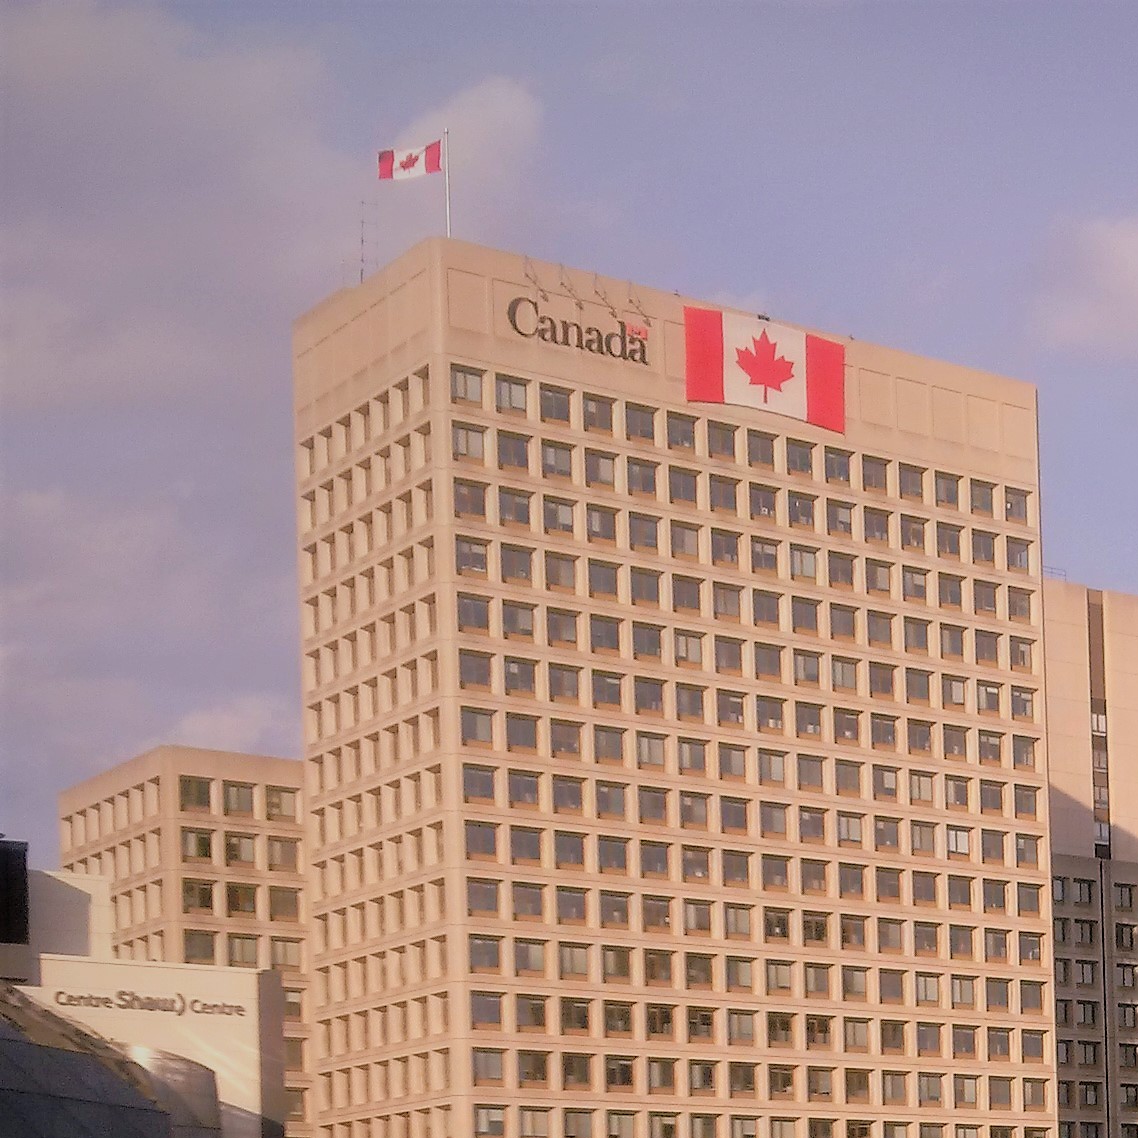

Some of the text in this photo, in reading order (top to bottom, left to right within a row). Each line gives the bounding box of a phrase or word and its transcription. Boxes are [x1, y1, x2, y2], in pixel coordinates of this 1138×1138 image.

[507, 296, 650, 365] Canada
[55, 990, 113, 1008] Centre
[190, 999, 247, 1016] Centre
